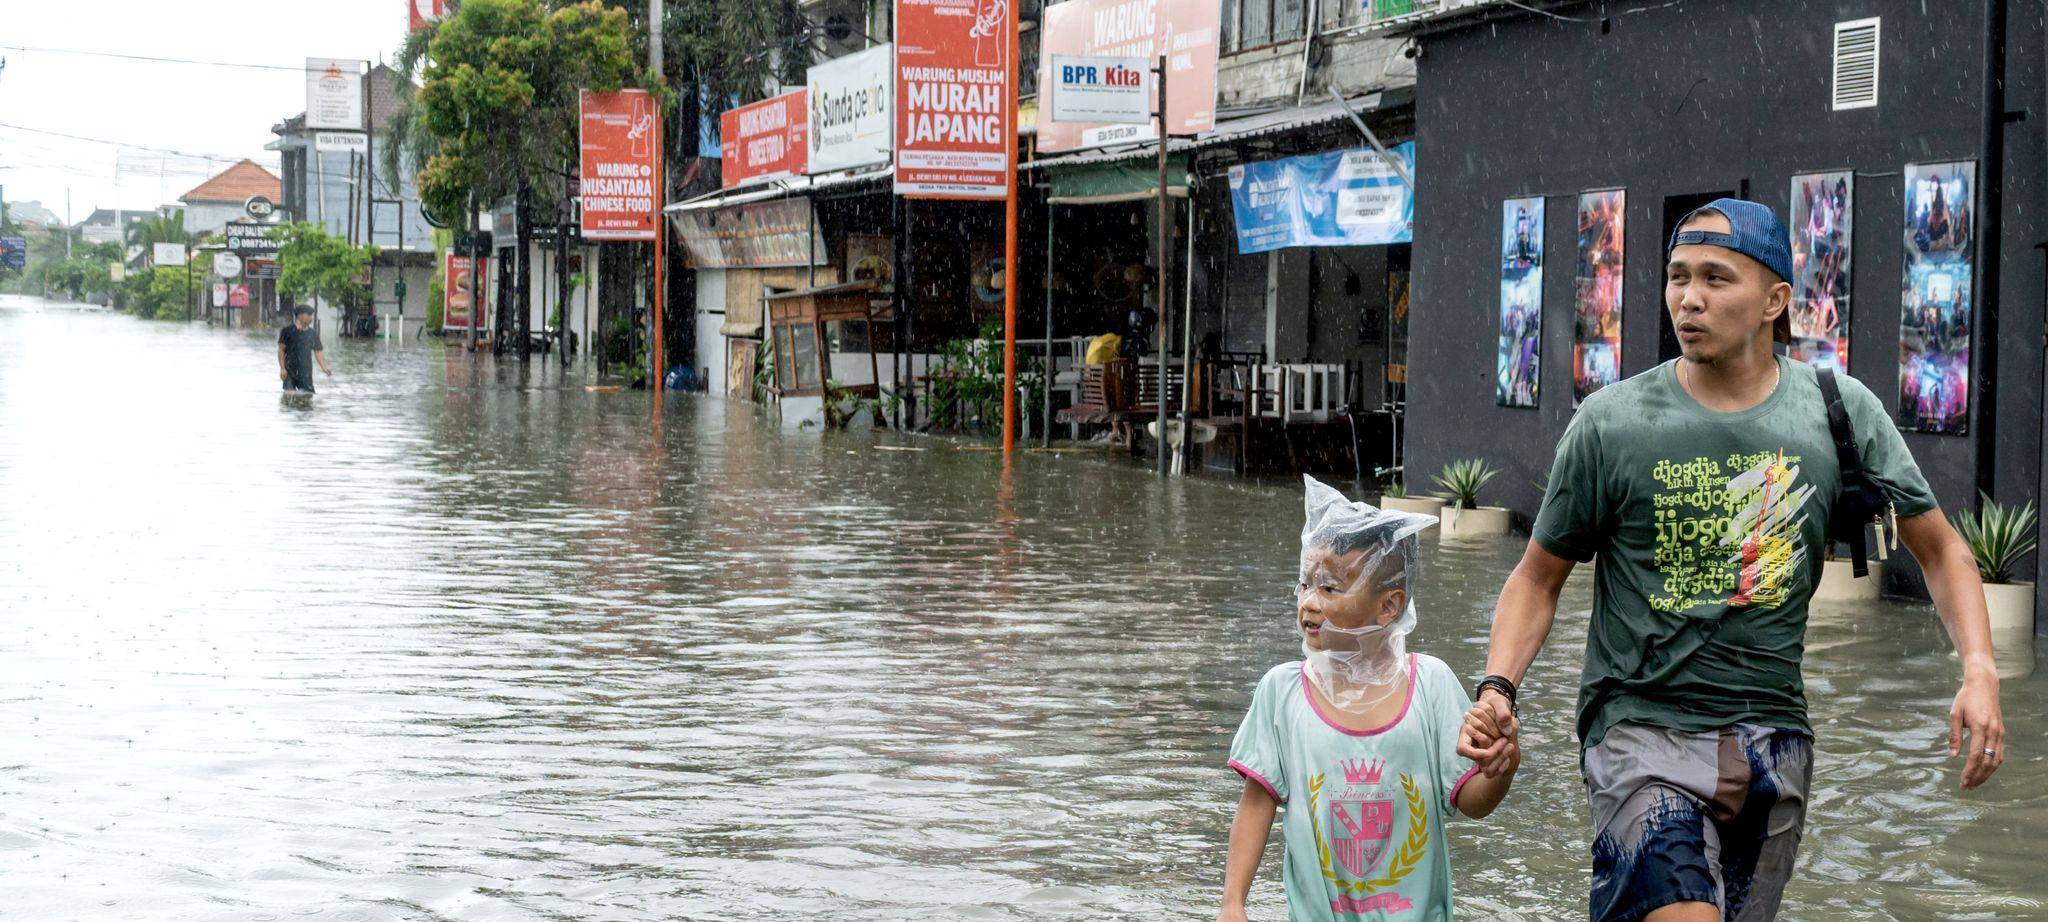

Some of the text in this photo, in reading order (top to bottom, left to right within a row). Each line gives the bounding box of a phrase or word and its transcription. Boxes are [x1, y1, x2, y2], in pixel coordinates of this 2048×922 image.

[1094, 0, 1156, 47] WARUNG
[901, 66, 1005, 84] WARUNG MUSLIM
[1105, 65, 1140, 86] Kita
[908, 82, 1000, 113] MURAH
[823, 87, 852, 128] Sunda
[905, 112, 1000, 145] JAPANG
[333, 136, 364, 145] EXTENSION
[596, 163, 639, 177] WARUNG
[916, 173, 932, 181] DEWI
[582, 178, 652, 196] NUSANTARA
[584, 197, 651, 212] CHINESE FOOD
[1653, 457, 1721, 483] djogdja
[1663, 567, 1735, 595] djogdja
[1339, 786, 1385, 799] Princess
